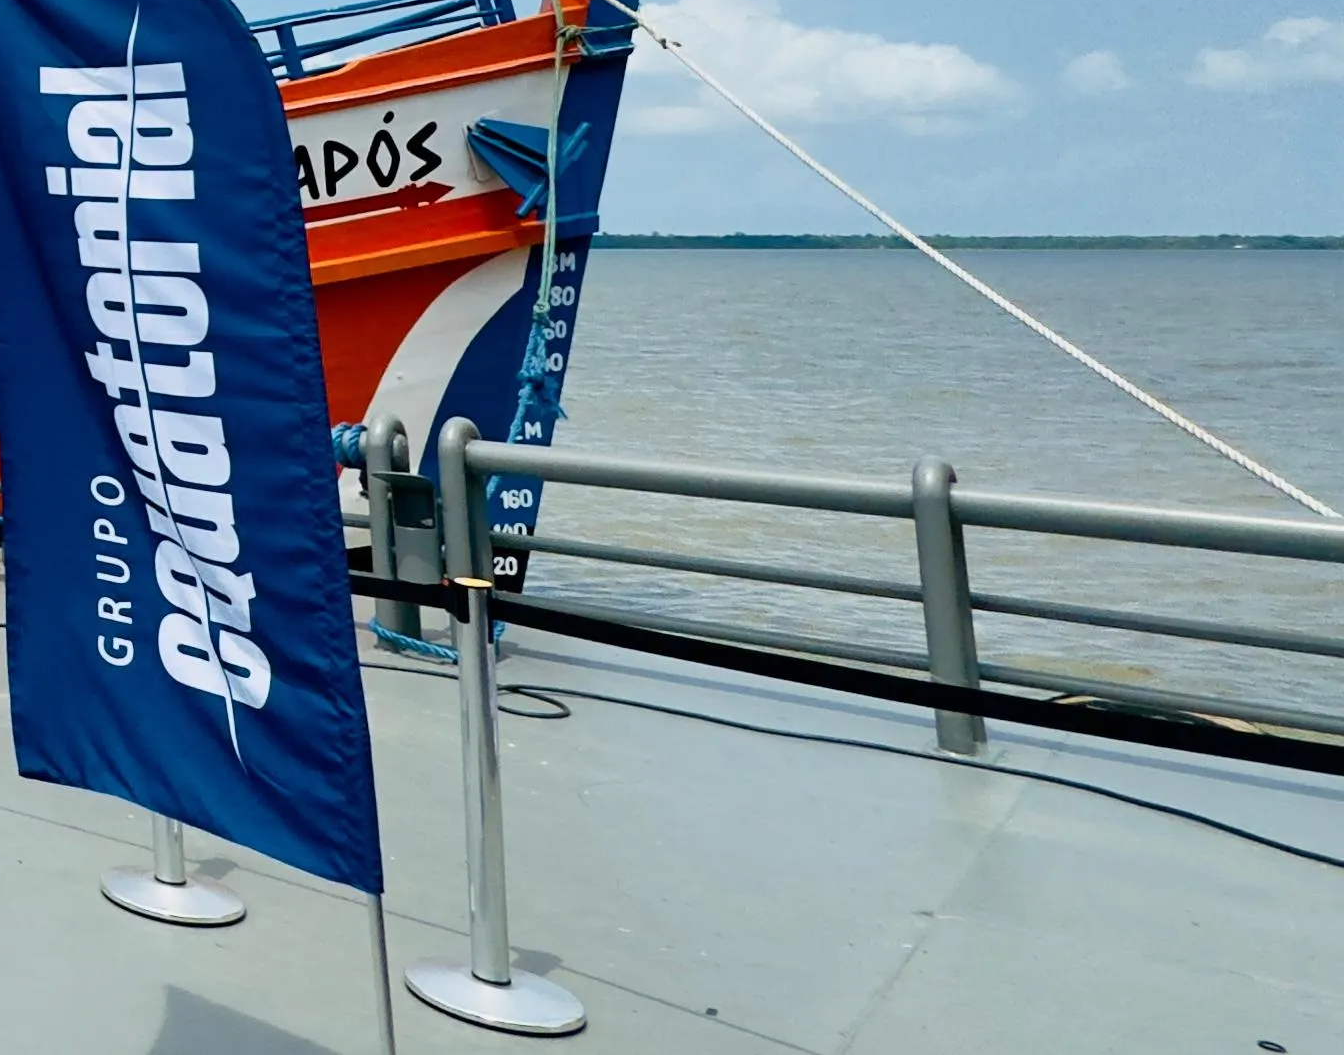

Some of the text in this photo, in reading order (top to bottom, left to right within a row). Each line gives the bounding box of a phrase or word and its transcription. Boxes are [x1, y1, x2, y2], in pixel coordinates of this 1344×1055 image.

[40, 61, 272, 710] equatorial
[90, 474, 136, 667] GRUPO
[499, 488, 534, 510] 160
